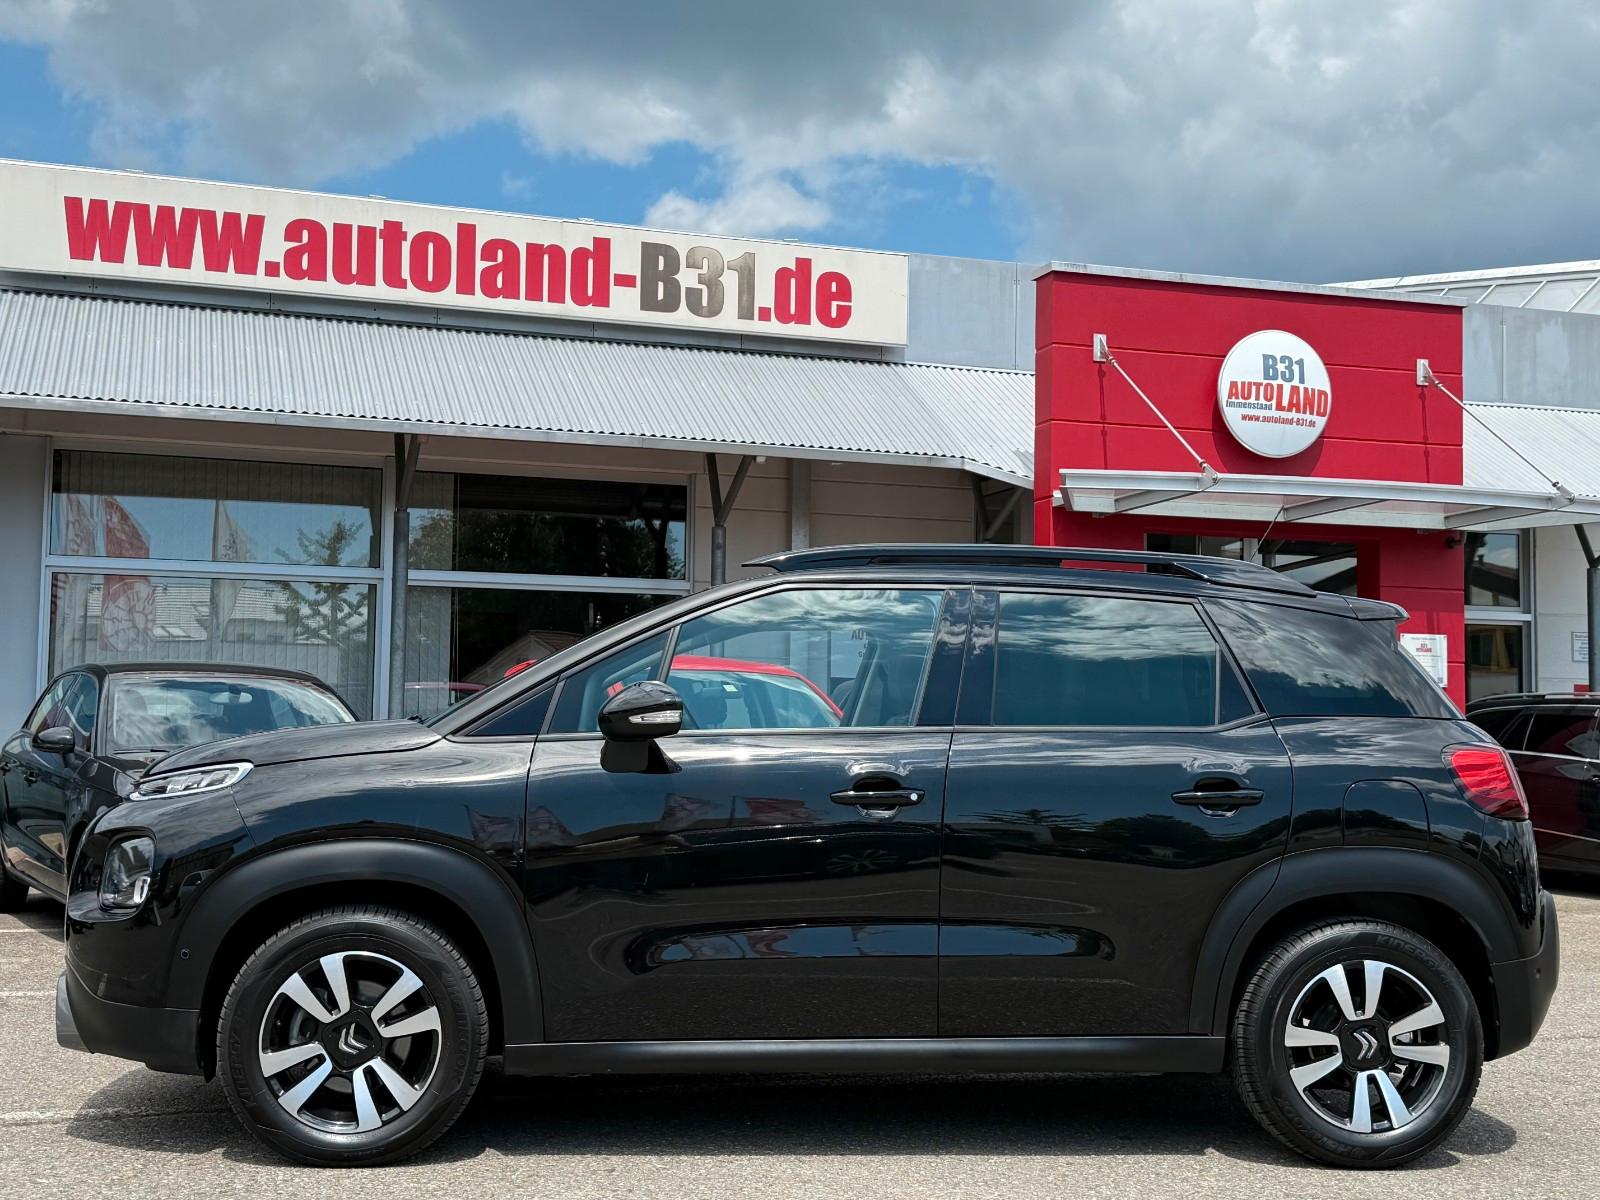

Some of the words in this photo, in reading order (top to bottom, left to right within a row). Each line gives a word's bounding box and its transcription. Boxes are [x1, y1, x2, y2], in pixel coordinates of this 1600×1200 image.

[64, 196, 852, 329] www.autoland-B31.de
[1262, 354, 1306, 384] B31
[1225, 399, 1273, 411] Immenstaad
[1228, 381, 1329, 418] AUTOLAND
[1241, 412, 1316, 428] www.autoland-B31.de
